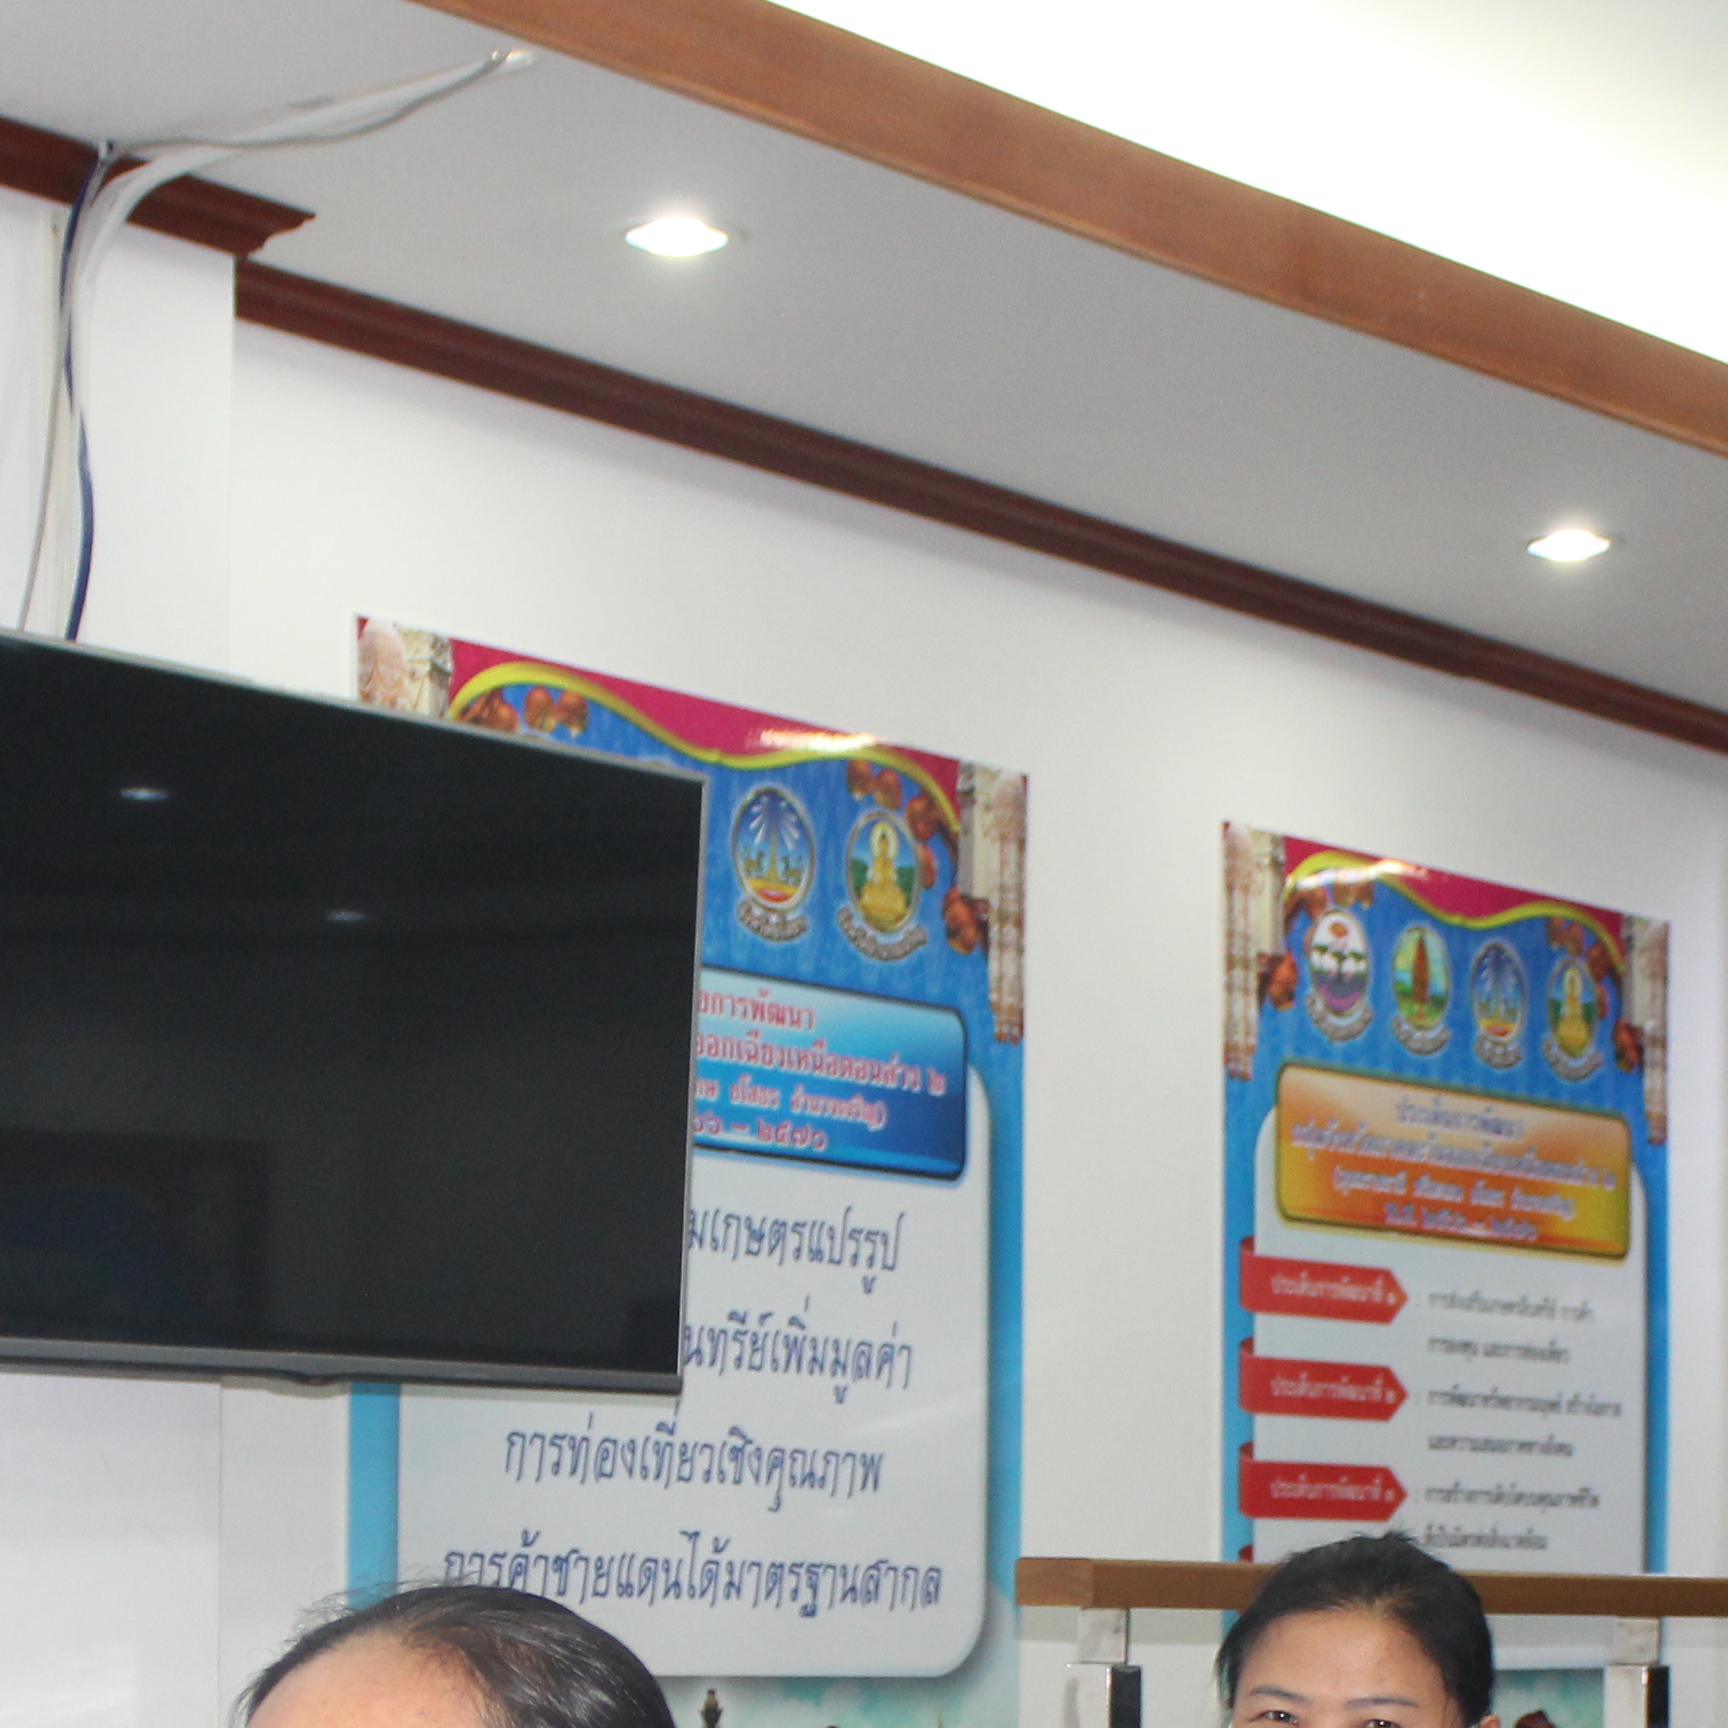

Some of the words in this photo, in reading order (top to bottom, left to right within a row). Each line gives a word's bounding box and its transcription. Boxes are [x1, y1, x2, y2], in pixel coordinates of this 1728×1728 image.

[504, 1400, 884, 1512] การท่องเที่ยวเชิงคุณภาพ
